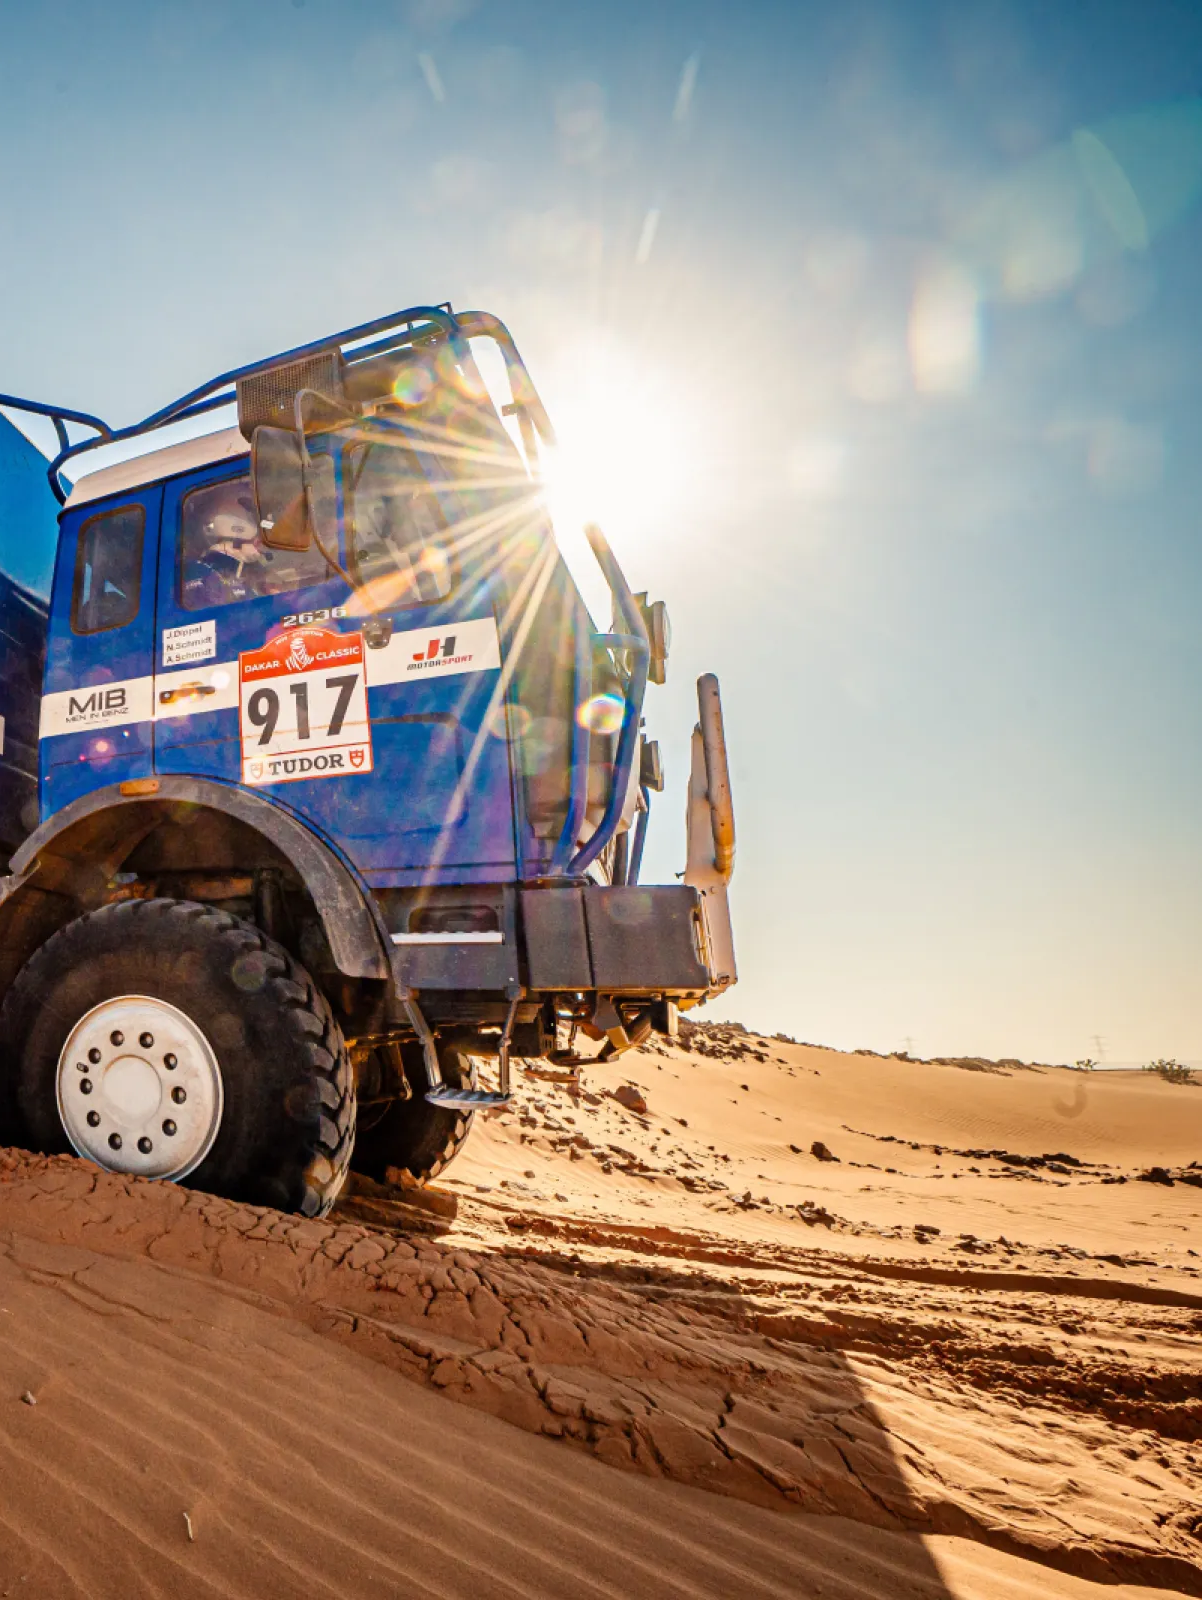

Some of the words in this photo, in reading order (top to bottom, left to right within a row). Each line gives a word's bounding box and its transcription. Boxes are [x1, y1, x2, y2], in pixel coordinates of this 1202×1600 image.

[282, 606, 347, 628] 2636
[244, 660, 280, 673] DAKAR
[316, 646, 360, 661] CLASSIC
[406, 654, 473, 671] MOTORSPORT
[68, 687, 126, 716] MIB
[247, 673, 359, 746] 917
[65, 714, 87, 723] MEN
[268, 753, 345, 776] TUDOR
